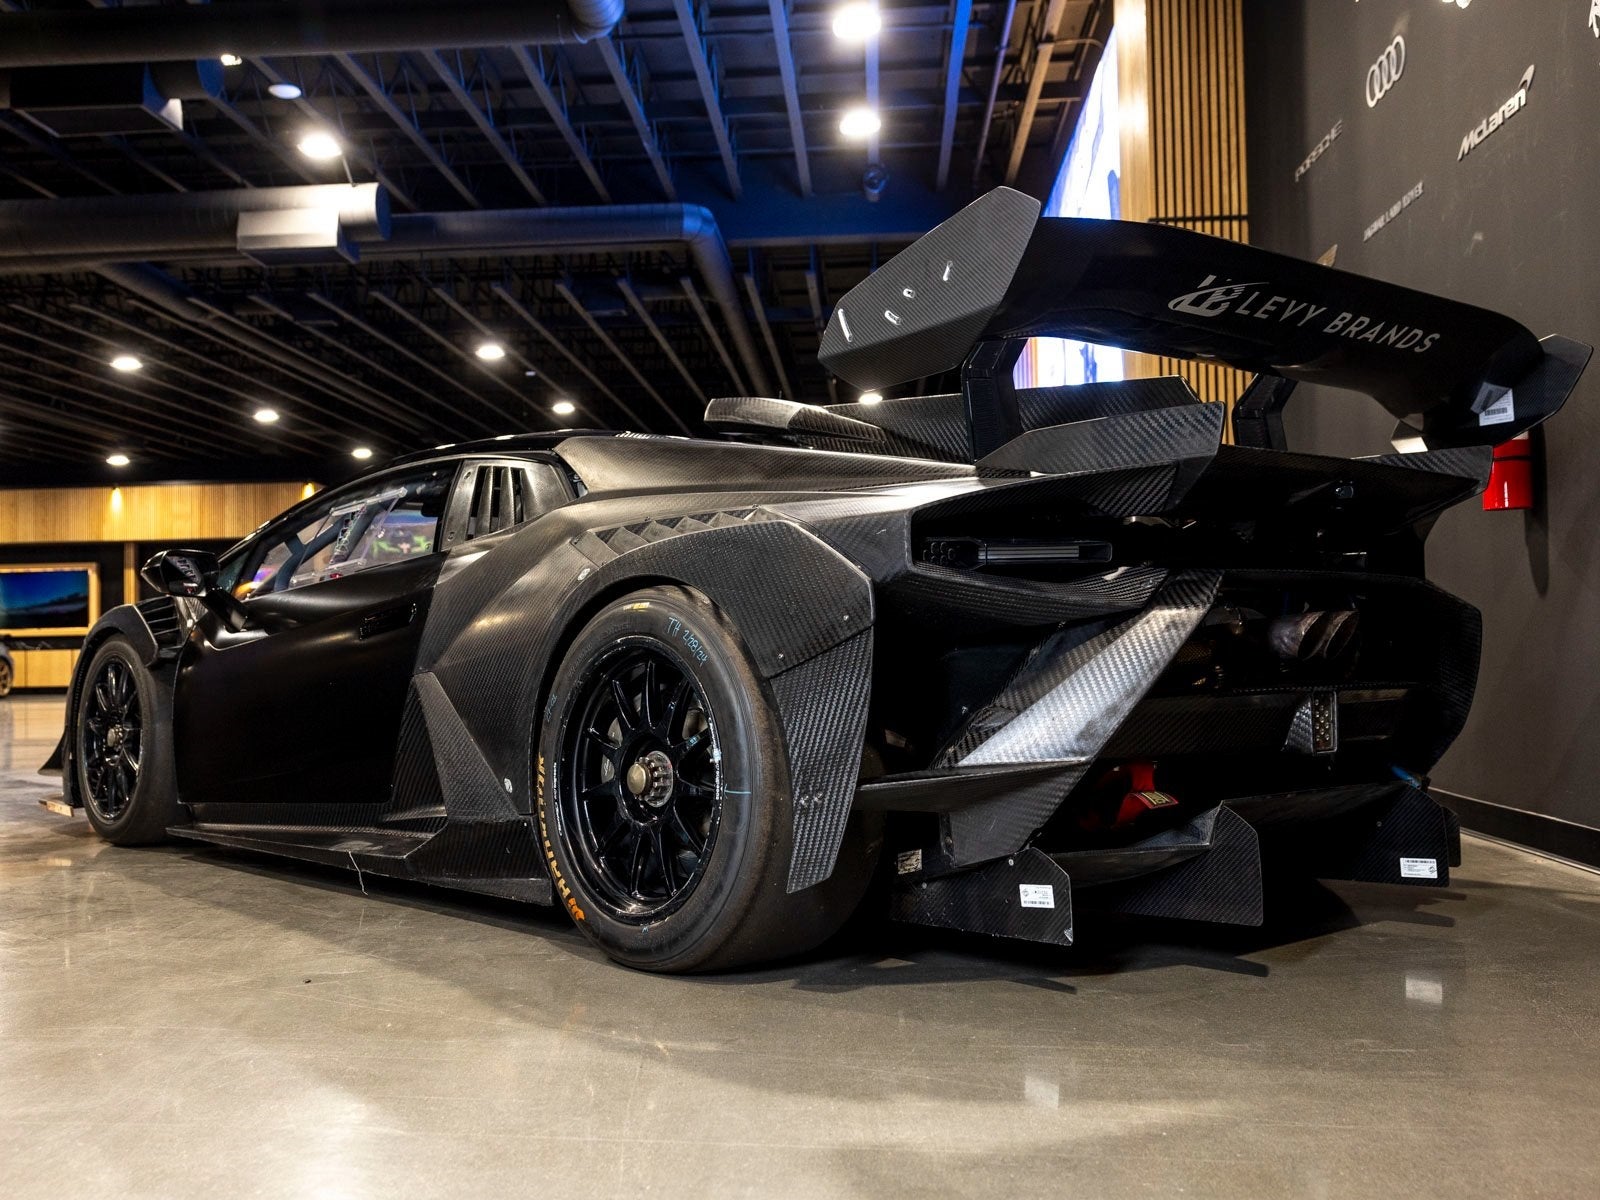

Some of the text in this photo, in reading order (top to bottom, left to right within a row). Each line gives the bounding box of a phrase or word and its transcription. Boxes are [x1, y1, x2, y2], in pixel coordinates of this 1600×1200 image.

[1295, 120, 1342, 182] PORSCHE
[1457, 88, 1526, 161] McLaren
[1235, 292, 1328, 327] LEVY
[1322, 312, 1441, 352] BRANDS
[667, 617, 709, 668] TH 2/28/24
